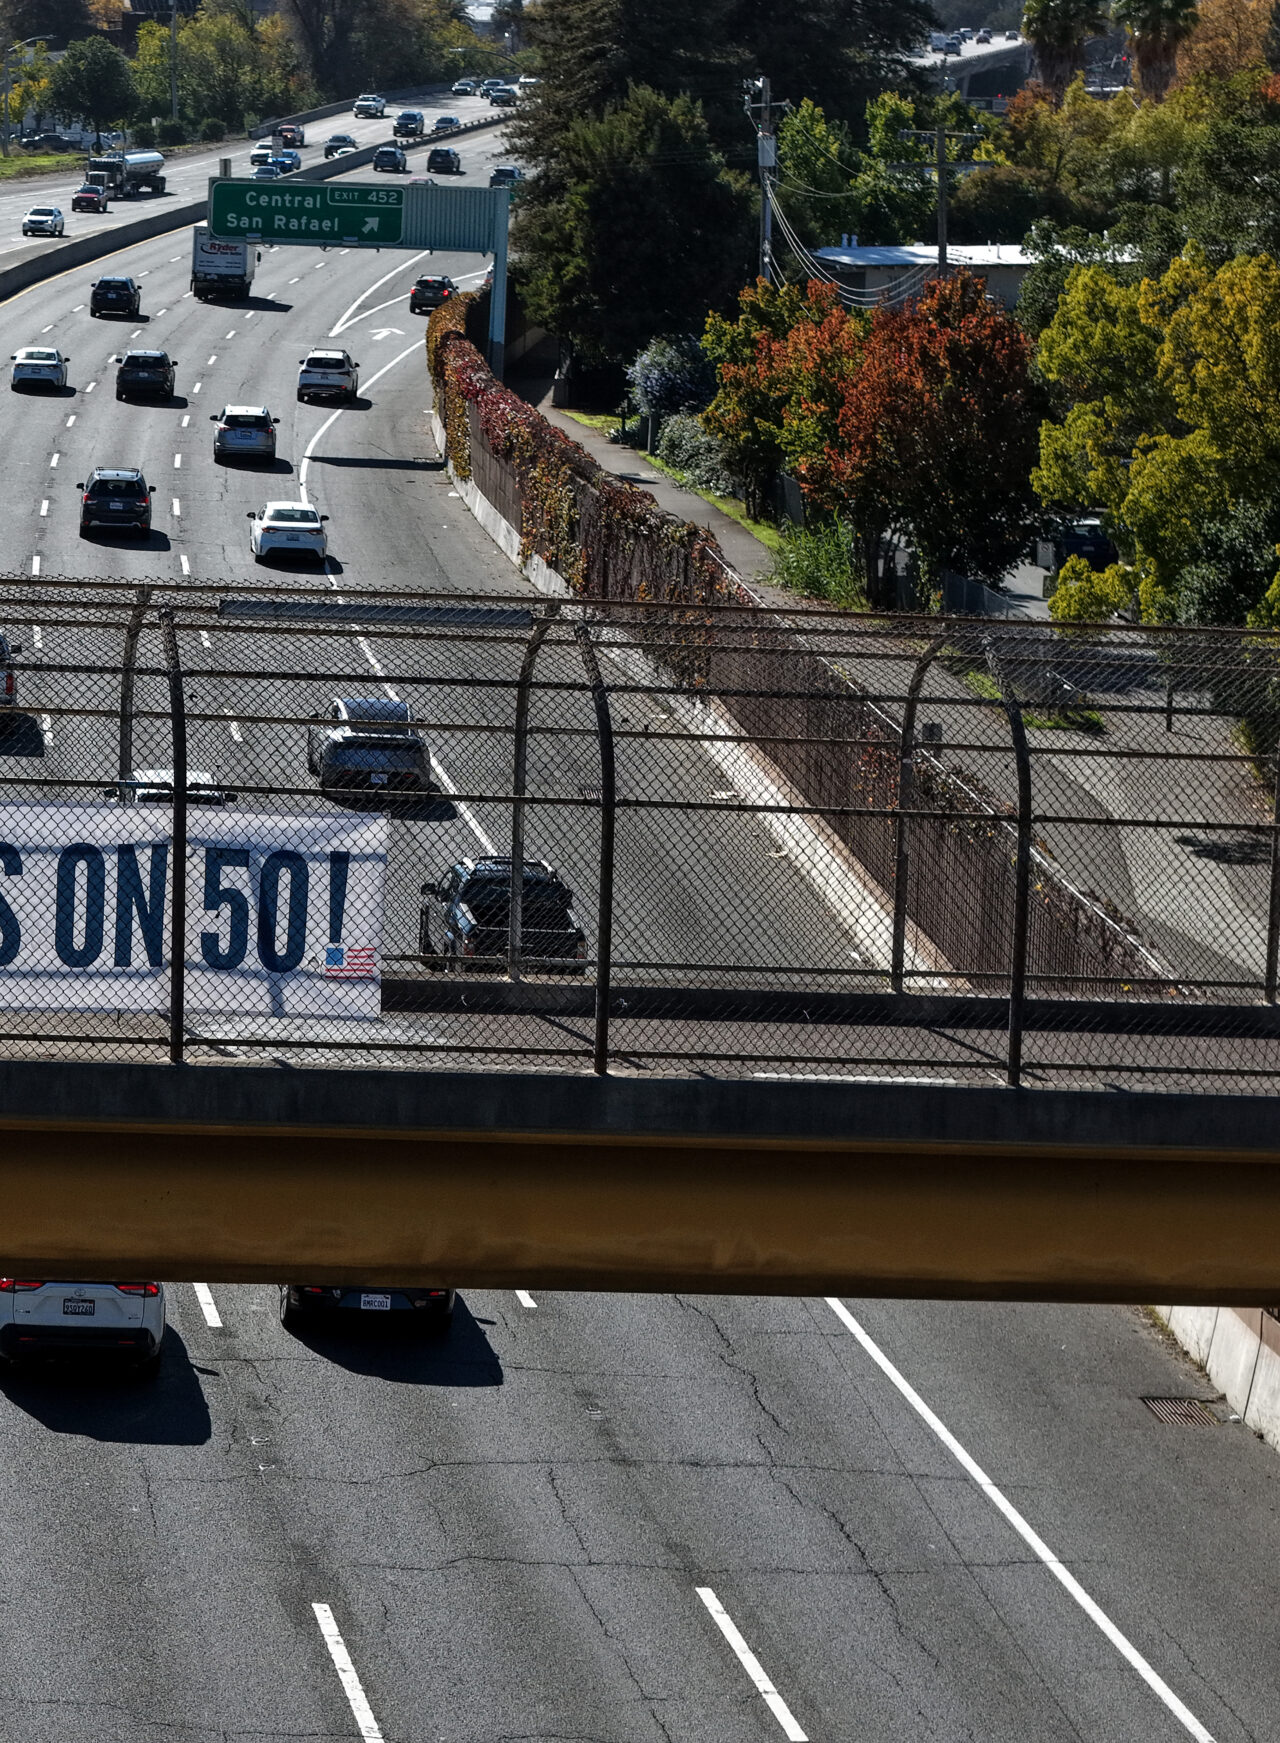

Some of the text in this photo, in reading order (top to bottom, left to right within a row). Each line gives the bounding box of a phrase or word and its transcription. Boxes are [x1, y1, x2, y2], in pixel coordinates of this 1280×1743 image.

[245, 191, 320, 208] Central
[334, 191, 398, 203] EXIT 452
[226, 213, 339, 231] San Rafael
[209, 242, 239, 253] Ryder
[55, 842, 169, 968] ON
[200, 846, 350, 974] 50!
